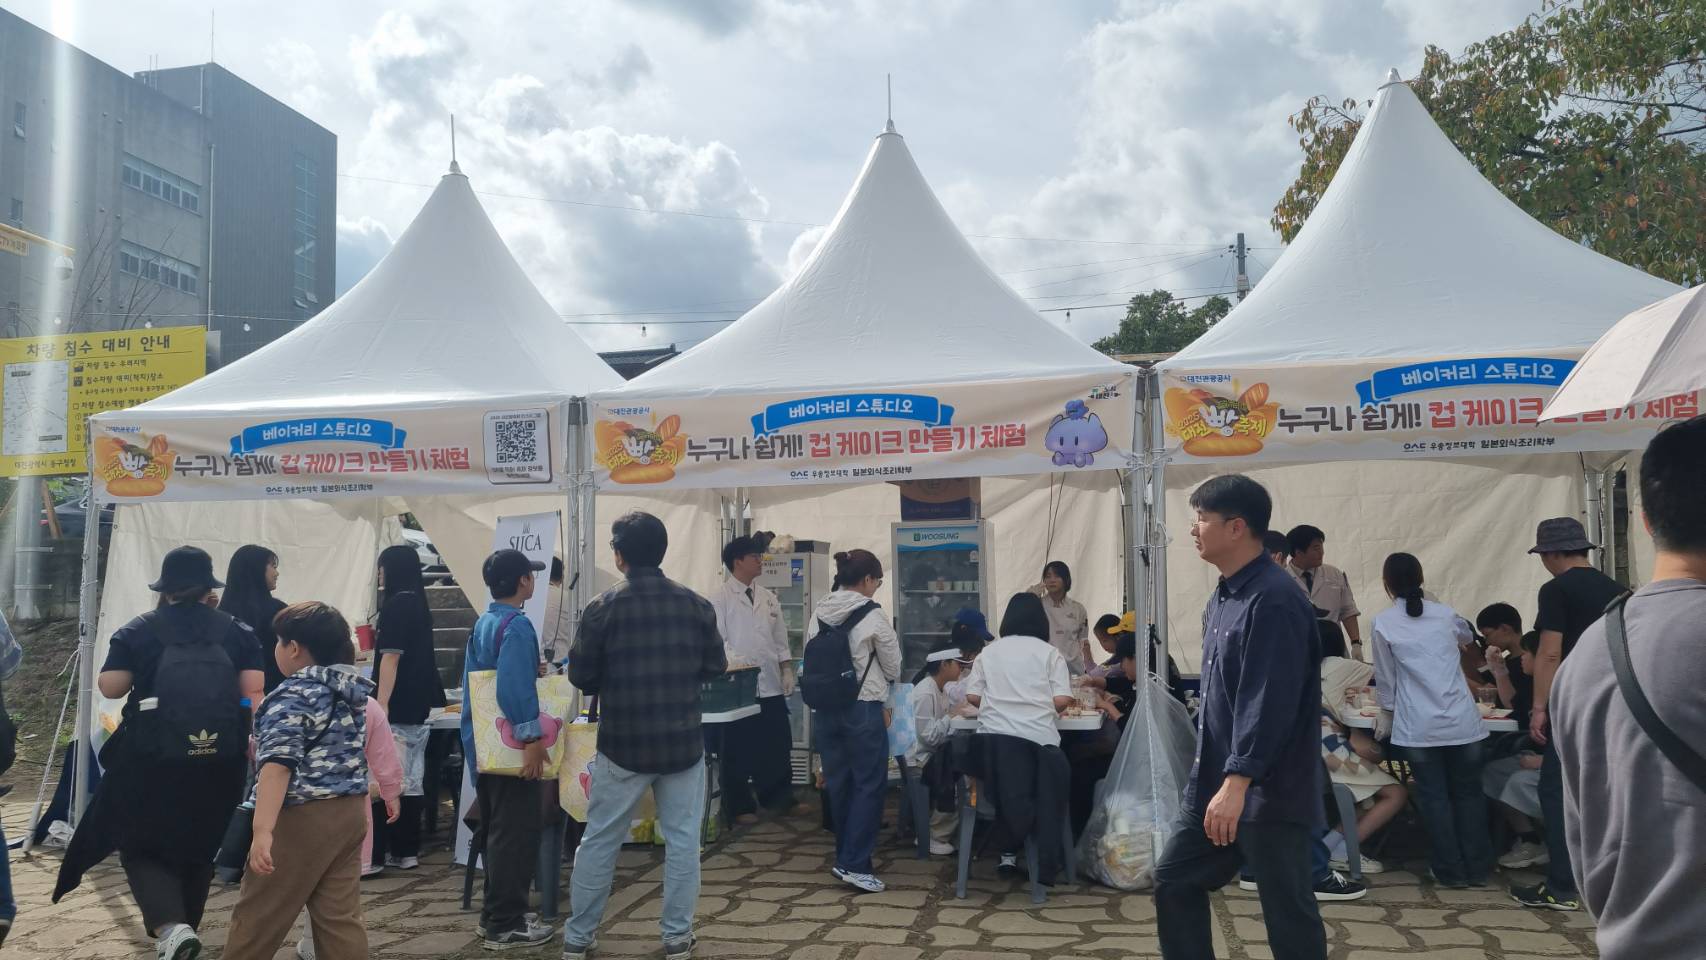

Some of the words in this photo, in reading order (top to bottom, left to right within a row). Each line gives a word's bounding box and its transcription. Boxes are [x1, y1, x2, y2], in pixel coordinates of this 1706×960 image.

[27, 343, 55, 358] 차량
[64, 340, 93, 357] 침수
[102, 337, 131, 352] 대비
[140, 335, 170, 352] 안내
[1187, 375, 1231, 383] 대전관광공사
[1401, 366, 1477, 386] 베이커리
[1484, 363, 1556, 379] 스튜디오
[788, 401, 849, 419] 베이커리
[855, 399, 913, 414] 스튜디오
[1279, 405, 1356, 433] 누구나
[1361, 403, 1421, 431] 쉽게!
[1428, 401, 1456, 428] 컵
[1462, 397, 1543, 426] 케이크
[263, 422, 317, 440] 베이커리
[322, 421, 372, 437] 스튜디오
[1183, 420, 1212, 441] 대전
[687, 438, 750, 462] 누구나
[755, 433, 803, 460] 쉽게!
[809, 432, 831, 458] 컵
[836, 429, 904, 457] 케이크
[908, 426, 976, 453] 만들기
[980, 423, 1026, 449] 체험
[1481, 437, 1556, 449] 일본외식조리학부
[174, 454, 231, 477] 누구나
[233, 453, 276, 477] 쉽게!
[280, 453, 299, 475] 컵
[304, 451, 364, 475] 케이크
[368, 449, 427, 473] 만들기
[430, 446, 470, 470] 체험
[852, 466, 912, 477] 일본외식조리학부
[921, 532, 959, 541] WOOSUNG
[187, 747, 217, 756] adidas
